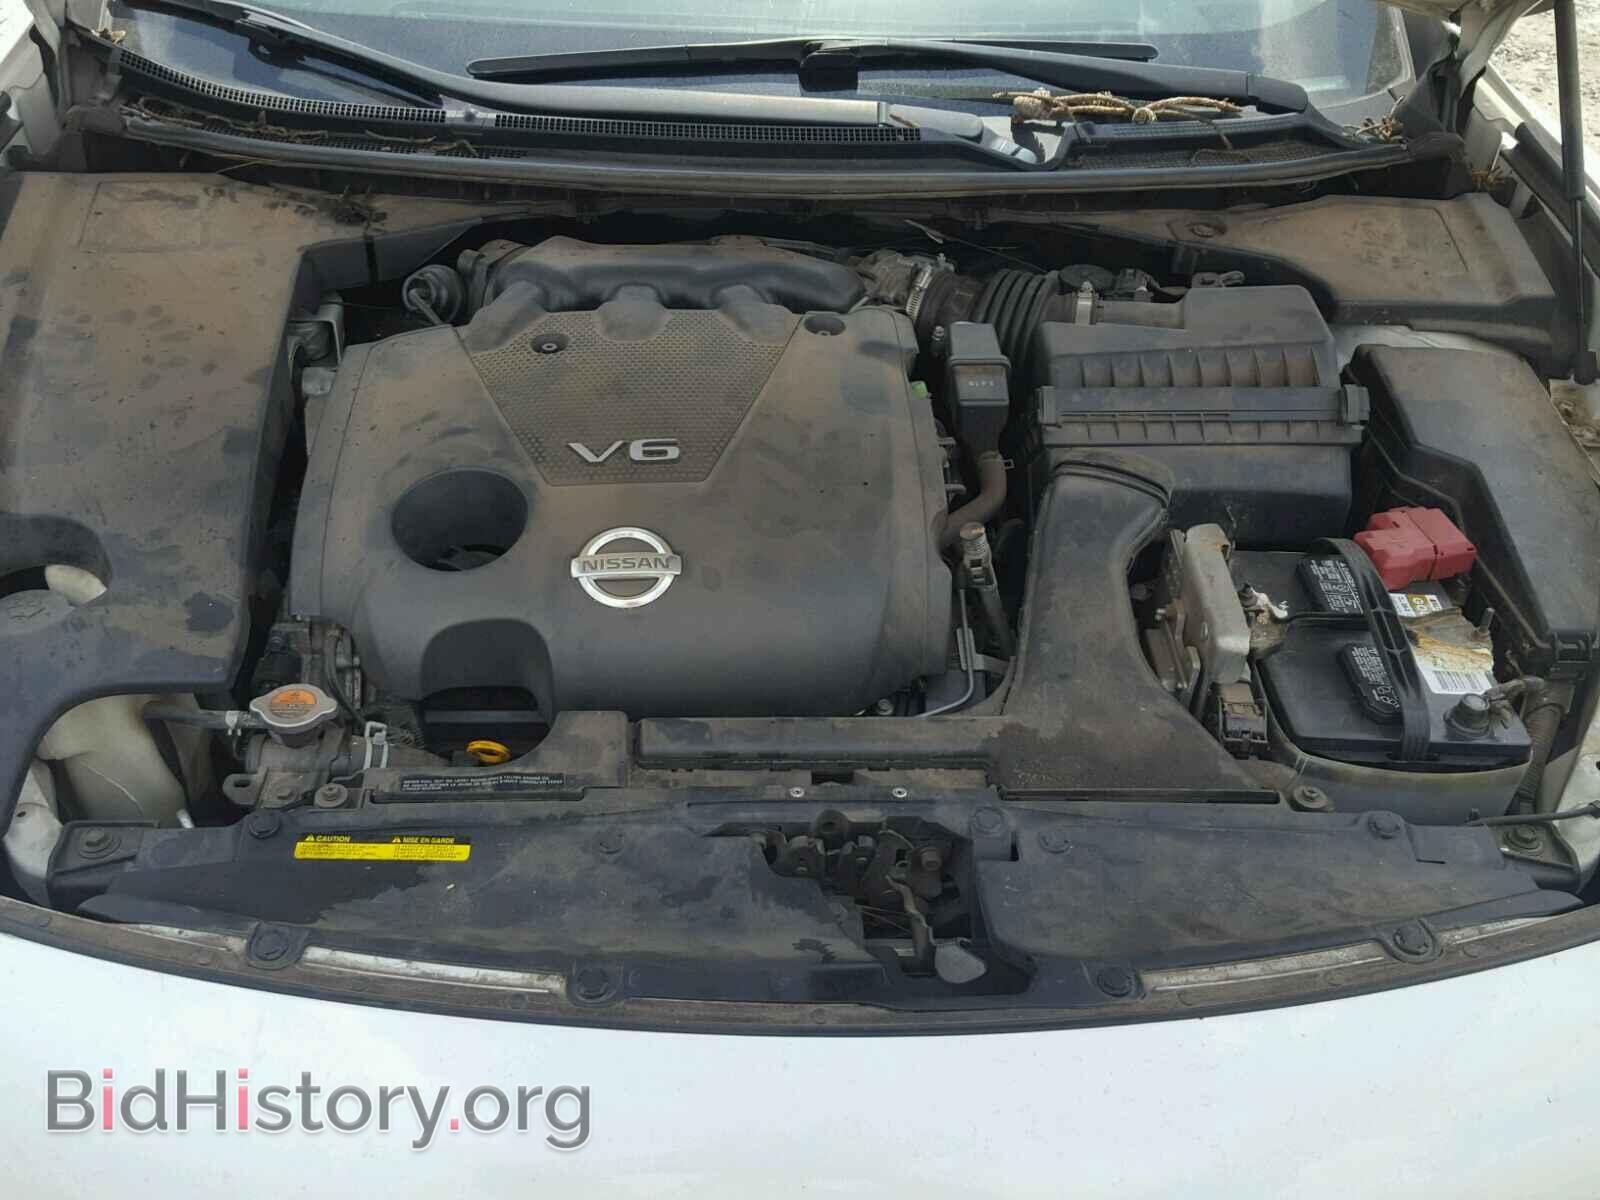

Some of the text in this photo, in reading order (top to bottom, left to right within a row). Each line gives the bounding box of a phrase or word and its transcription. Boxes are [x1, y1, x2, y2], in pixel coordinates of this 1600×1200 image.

[568, 438, 680, 463] V6
[582, 557, 671, 572] NISSAN
[316, 835, 351, 843] CAUTION
